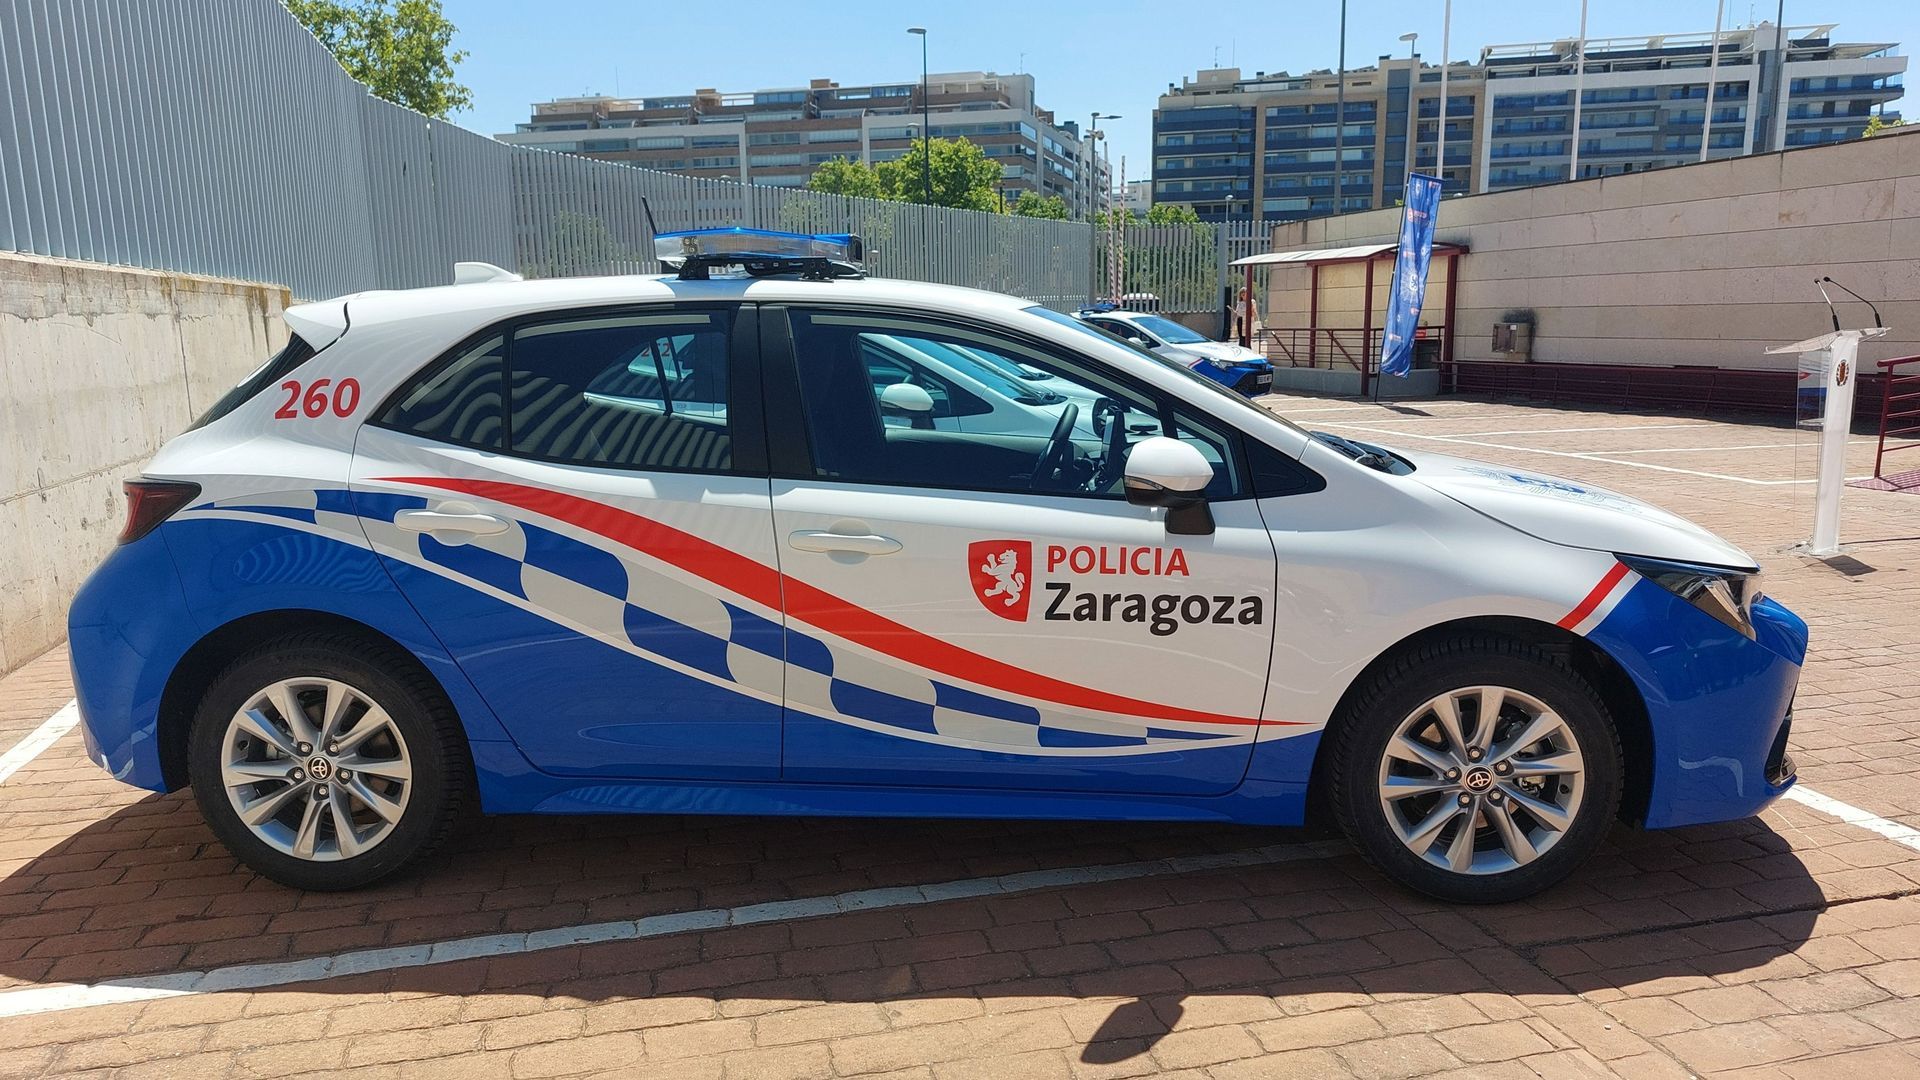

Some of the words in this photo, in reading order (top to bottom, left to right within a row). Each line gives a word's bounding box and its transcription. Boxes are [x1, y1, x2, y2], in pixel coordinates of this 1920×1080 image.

[275, 377, 361, 419] 260
[1047, 545, 1190, 577] POLICIA
[1044, 582, 1263, 637] Zaragoza
